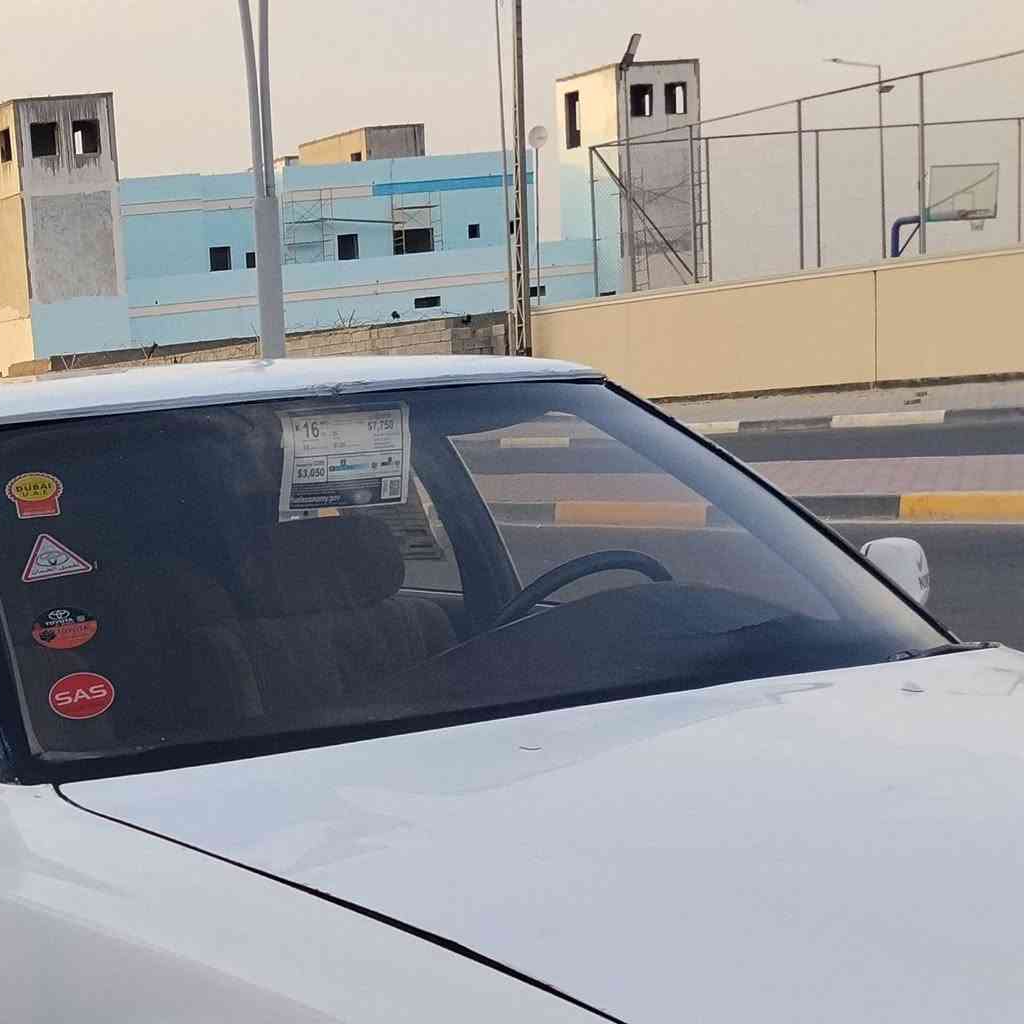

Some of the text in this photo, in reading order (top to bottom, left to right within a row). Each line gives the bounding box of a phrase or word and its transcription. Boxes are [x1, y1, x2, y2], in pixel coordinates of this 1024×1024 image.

[303, 421, 320, 438] 16
[15, 483, 52, 493] DUBAI
[54, 684, 108, 706] SAS
